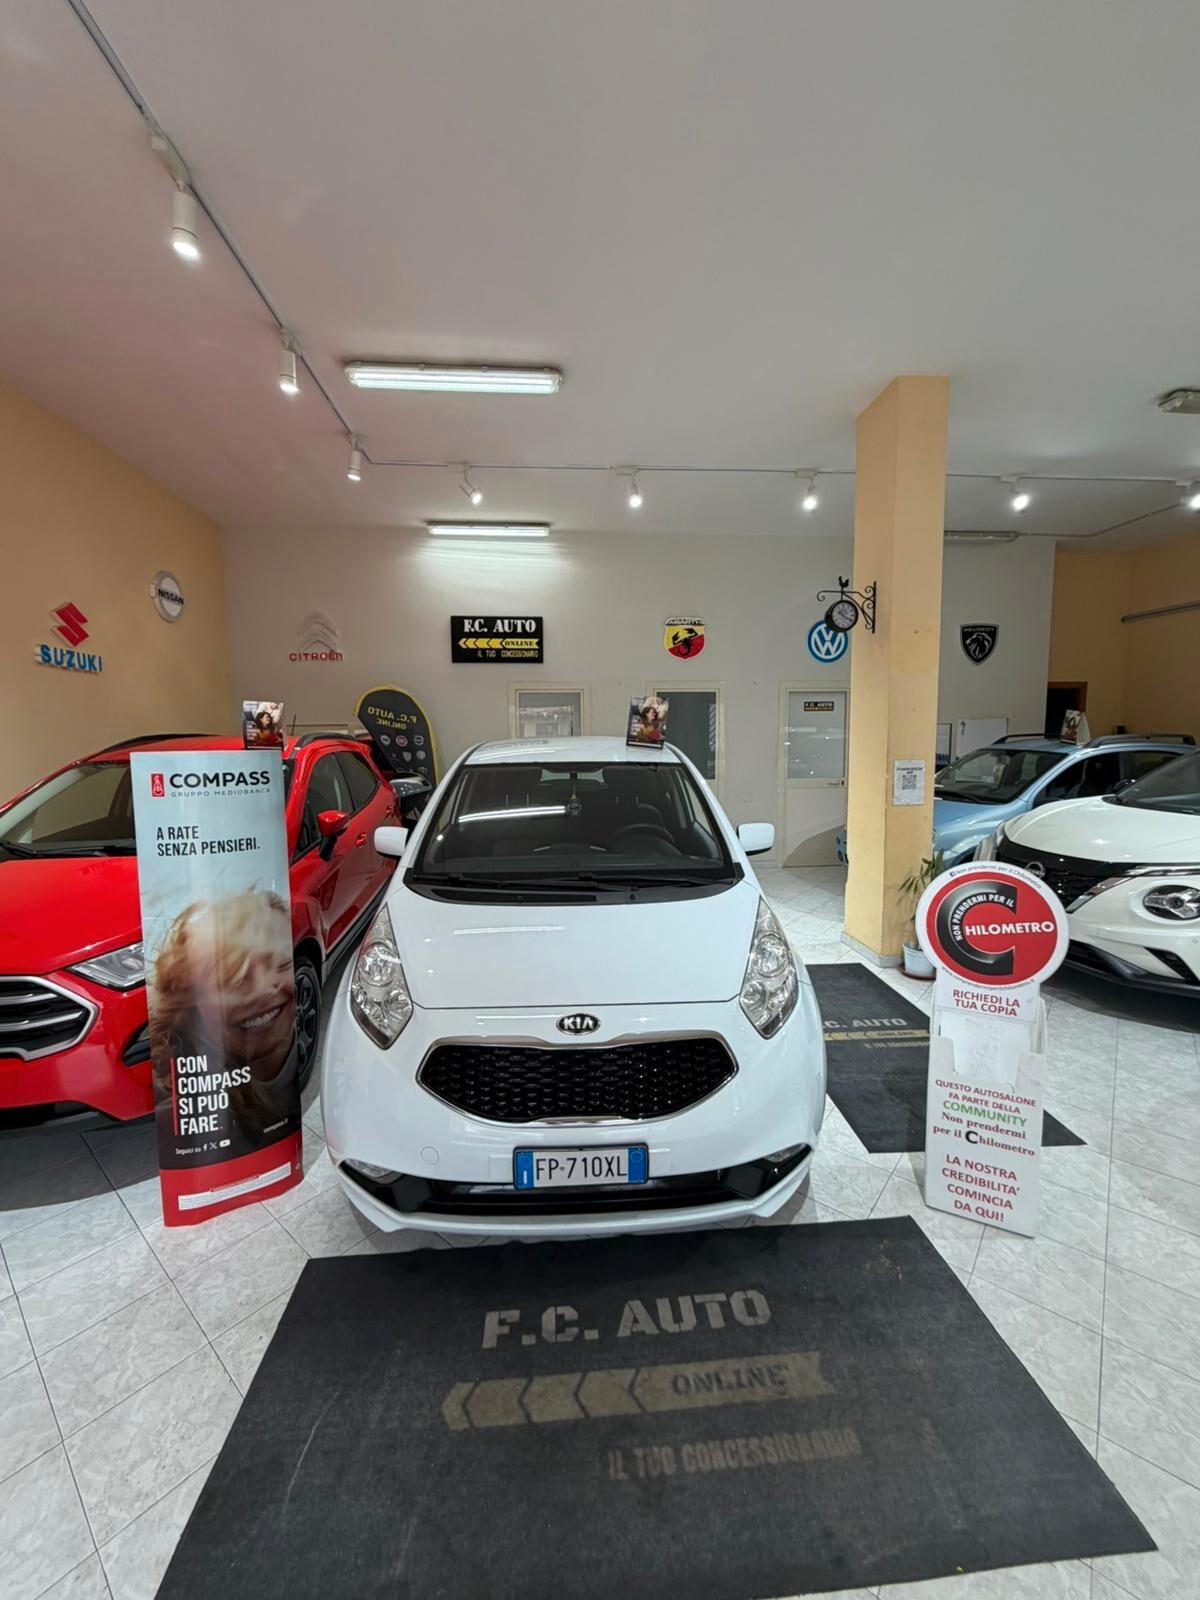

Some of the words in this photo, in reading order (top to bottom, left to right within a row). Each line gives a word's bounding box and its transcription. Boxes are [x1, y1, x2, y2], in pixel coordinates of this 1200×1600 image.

[158, 588, 185, 606] NISSAN
[463, 618, 487, 633] F.C.
[493, 618, 536, 633] AUTO
[39, 643, 103, 673] SUZUKI
[477, 650, 483, 658] IL
[486, 650, 496, 658] TUO
[501, 650, 539, 658] CONCESSIONARIO
[169, 770, 271, 789] COMPASS
[171, 790, 210, 798] GRUPPO
[215, 788, 271, 797] MEDIOBANCA
[156, 827, 164, 841] A
[168, 825, 199, 840] RATE
[157, 842, 197, 857] SENZA
[201, 837, 261, 855] PENSIERI.
[988, 894, 1005, 903] PER
[1006, 898, 1014, 907] IL
[952, 894, 987, 925] PRENDERMI
[951, 925, 963, 941] NON
[952, 989, 1003, 1005] RICHIEDI
[1006, 997, 1020, 1008] LA
[955, 998, 978, 1010] TUA
[980, 1003, 1017, 1017] COPIA
[563, 1016, 595, 1030] KIA
[852, 1017, 908, 1027] AUTO
[176, 1055, 208, 1074] CON
[178, 1066, 252, 1095] COMPASS
[179, 1098, 193, 1116] SI
[197, 1089, 229, 1114] PUÒ
[935, 1078, 972, 1094] QUESTO
[973, 1086, 1037, 1107] AUTOSALONE
[948, 1091, 960, 1102] FA
[962, 1093, 990, 1108] PARTE
[992, 1101, 1021, 1115] DELLA
[942, 1099, 1028, 1128] COMMUNITY
[942, 1111, 963, 1125] Non
[966, 1119, 1026, 1140] prendermi
[933, 1125, 952, 1137] per
[954, 1129, 962, 1139] il
[964, 1130, 1036, 1157] Chilometro
[946, 1153, 961, 1167] LA
[964, 1159, 1017, 1182] NOSTRA
[946, 1183, 1013, 1210] COMINCIA
[954, 1199, 972, 1213] DA
[975, 1205, 1004, 1222] QUI!
[481, 1306, 600, 1350] F.C.
[616, 1289, 772, 1339] AUTO
[671, 1363, 789, 1397] ONLINE
[607, 1449, 626, 1481] IL
[633, 1444, 677, 1479] TUO
